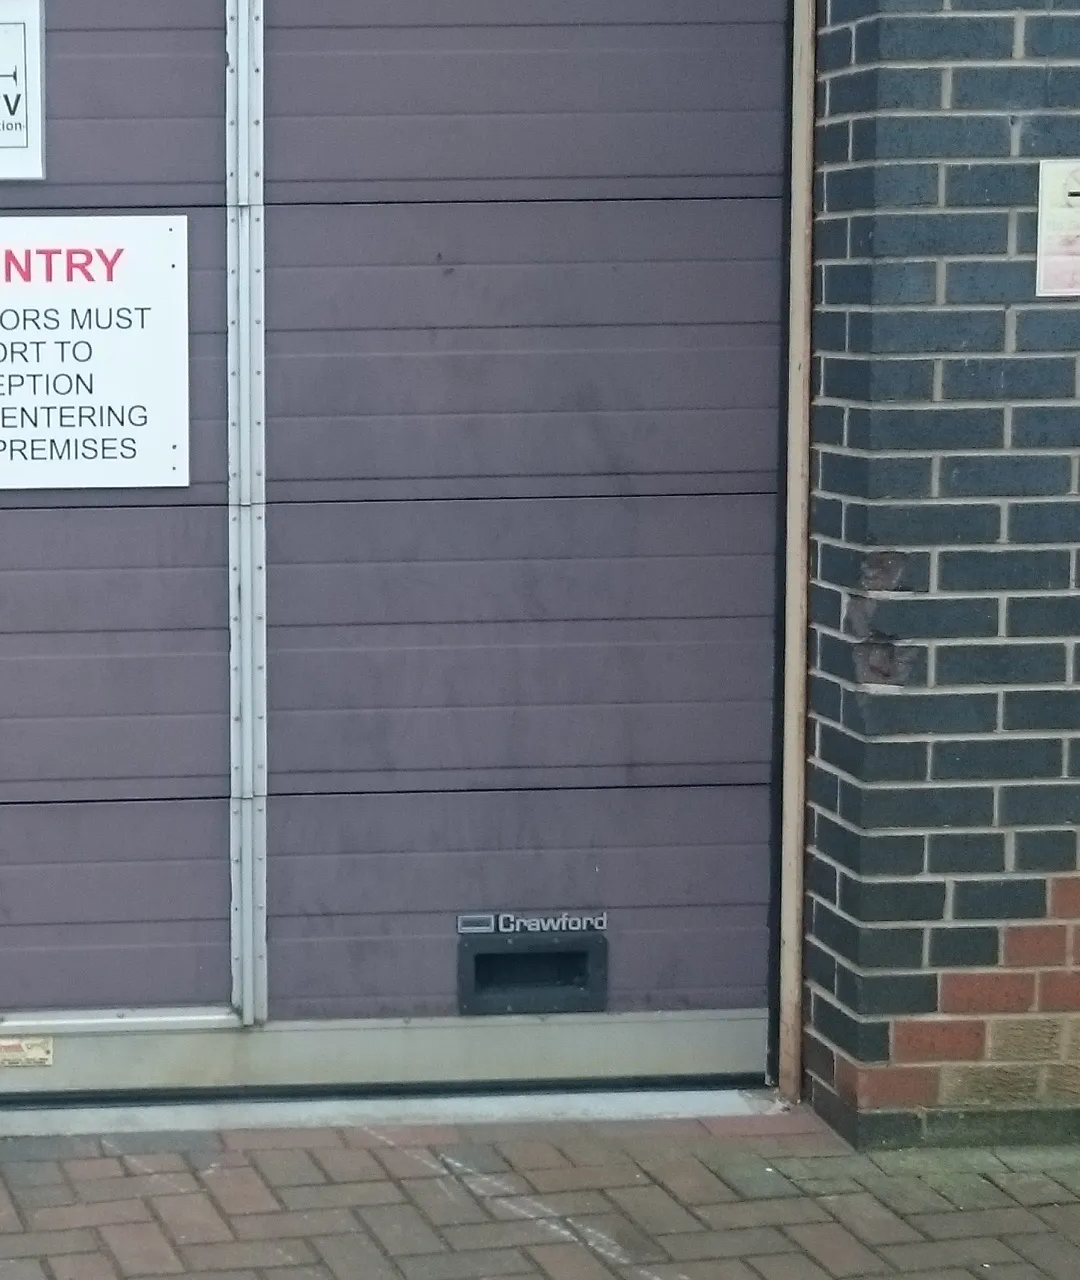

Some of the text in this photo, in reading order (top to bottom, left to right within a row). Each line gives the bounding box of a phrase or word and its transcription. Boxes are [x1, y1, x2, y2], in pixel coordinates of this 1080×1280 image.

[71, 307, 151, 330] MUST
[55, 340, 92, 363] TO
[1, 405, 148, 428] ENTERING
[498, 912, 608, 933] Crawford
